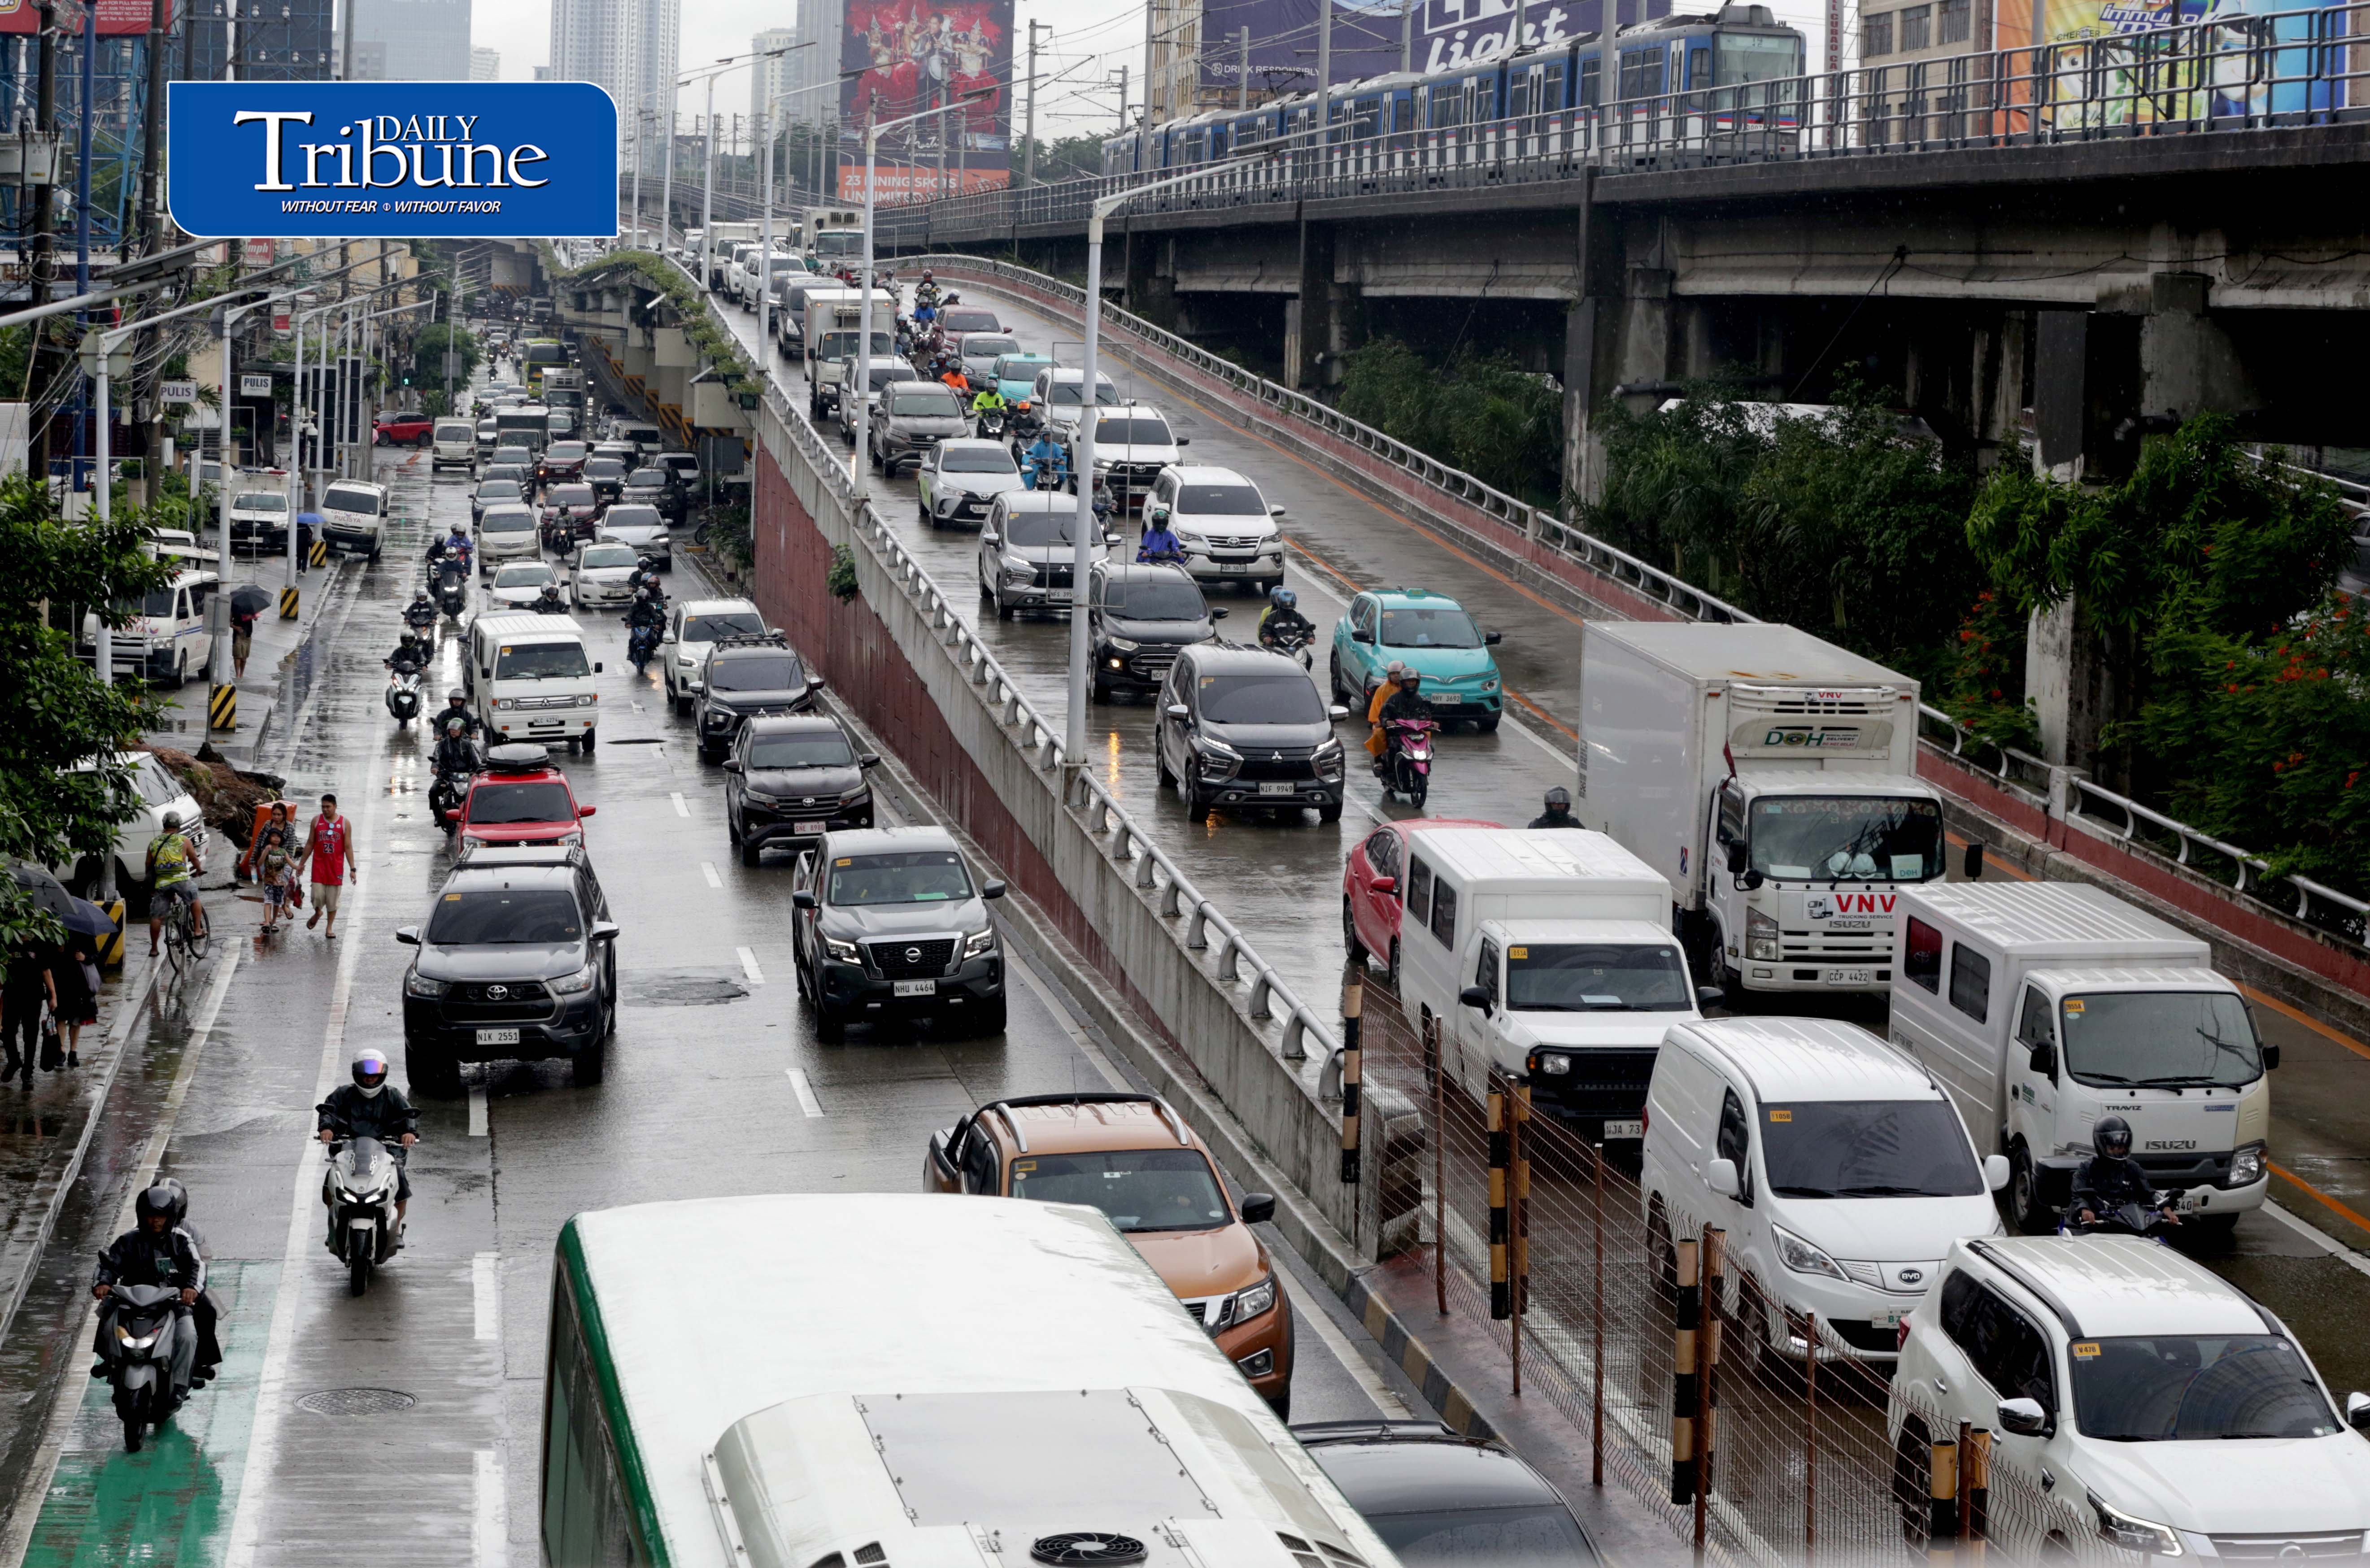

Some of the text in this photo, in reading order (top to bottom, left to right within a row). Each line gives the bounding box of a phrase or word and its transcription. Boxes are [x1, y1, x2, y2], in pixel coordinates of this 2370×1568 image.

[1224, 65, 1253, 74] DRIK
[845, 175, 861, 186] 23
[865, 176, 911, 187] INING
[244, 378, 269, 388] PULIS
[161, 387, 191, 397] PULIS
[323, 843, 334, 854] 25
[1835, 895, 1896, 912] VNV
[1830, 973, 1868, 981] CCP 4422
[915, 984, 933, 992] 4464
[499, 1032, 518, 1041] 2551
[1606, 1124, 1643, 1135] NJA 73
[2146, 1140, 2196, 1150] ISUZU
